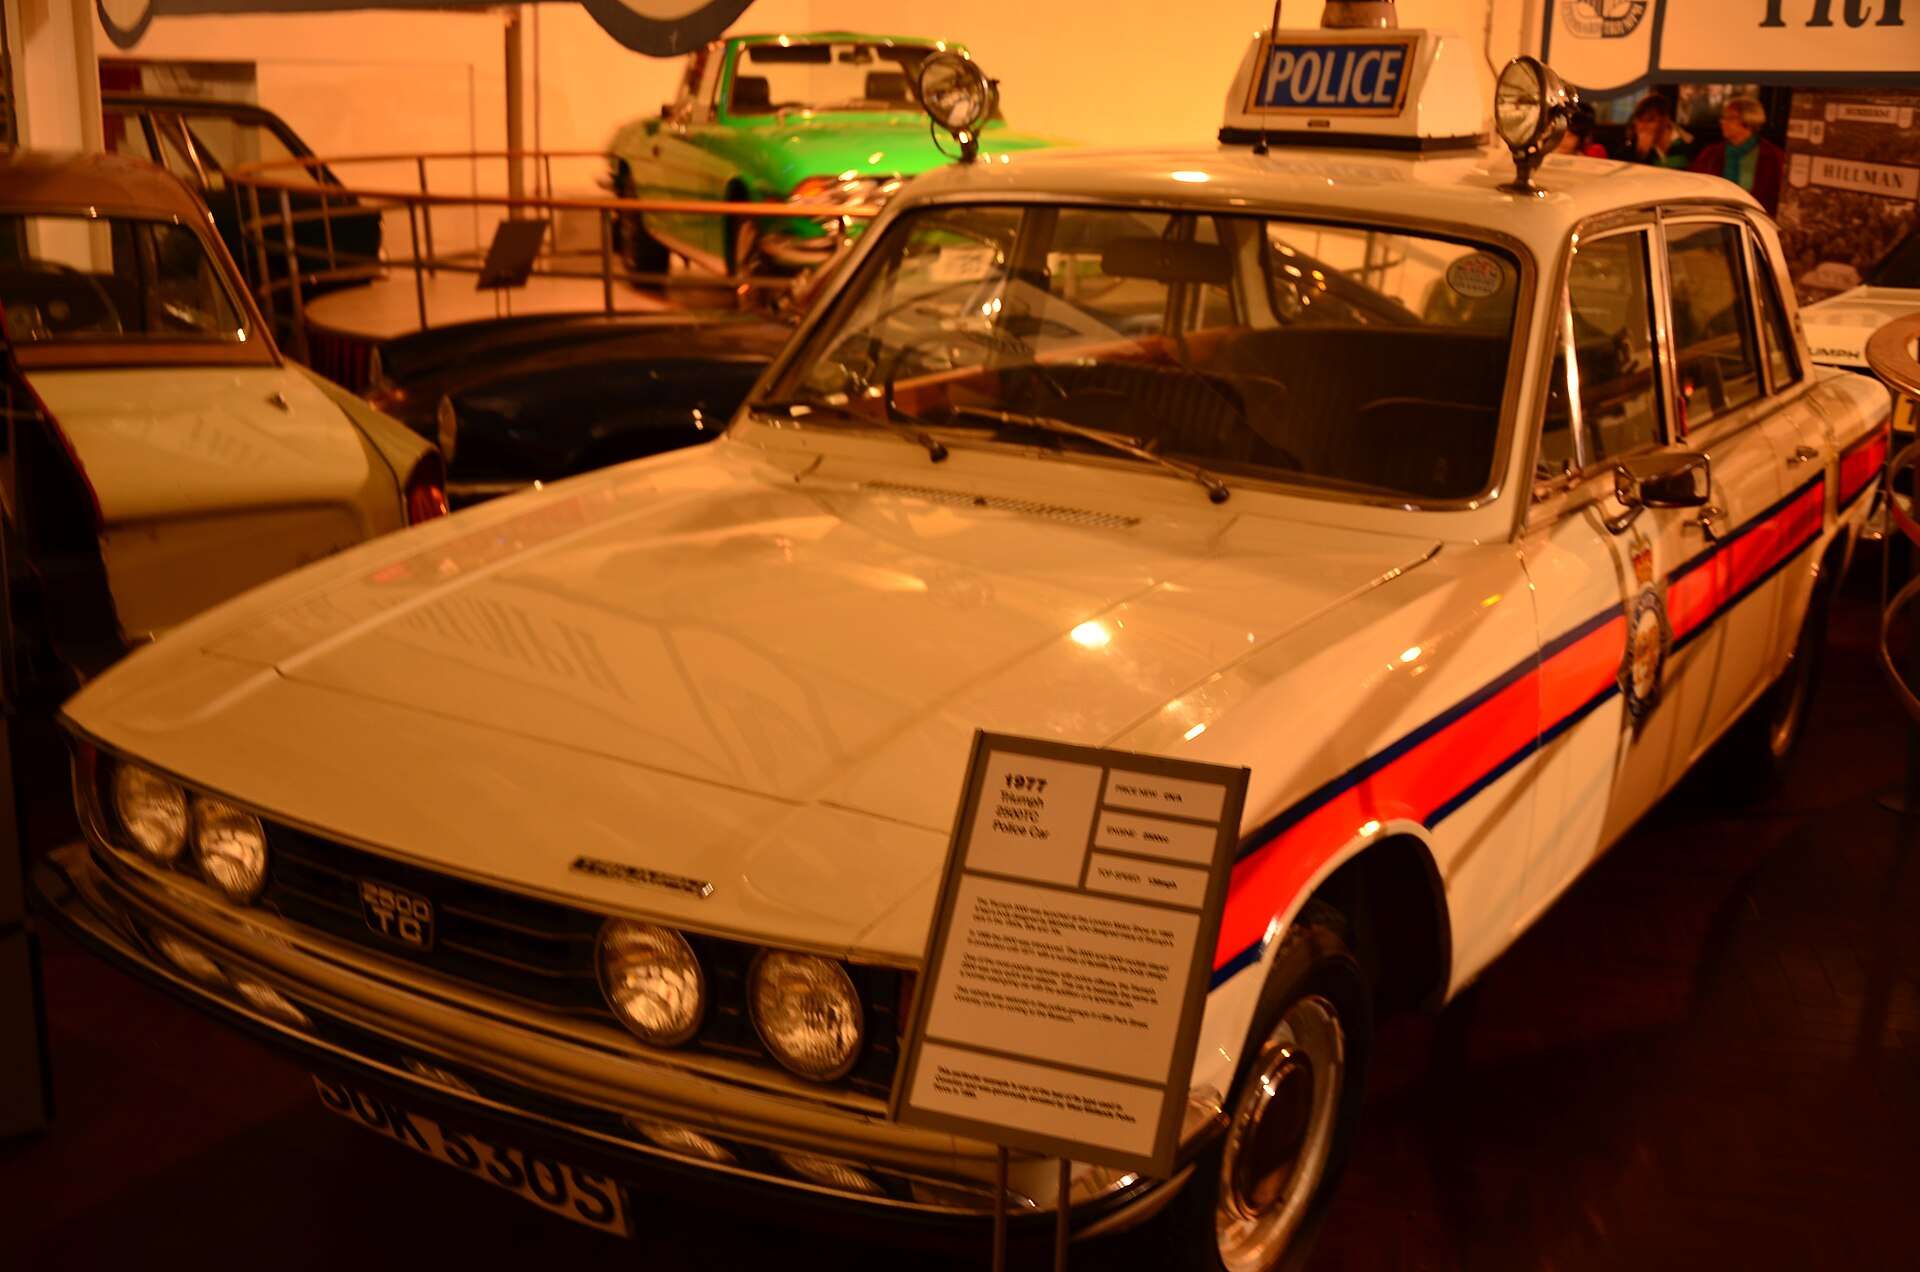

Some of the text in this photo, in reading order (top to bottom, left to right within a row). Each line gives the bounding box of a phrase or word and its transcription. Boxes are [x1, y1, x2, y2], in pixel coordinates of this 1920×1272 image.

[1265, 49, 1402, 104] POLICE
[1824, 163, 1904, 189] HILLMAN
[1005, 773, 1048, 793] 1977
[362, 881, 431, 922] 2500
